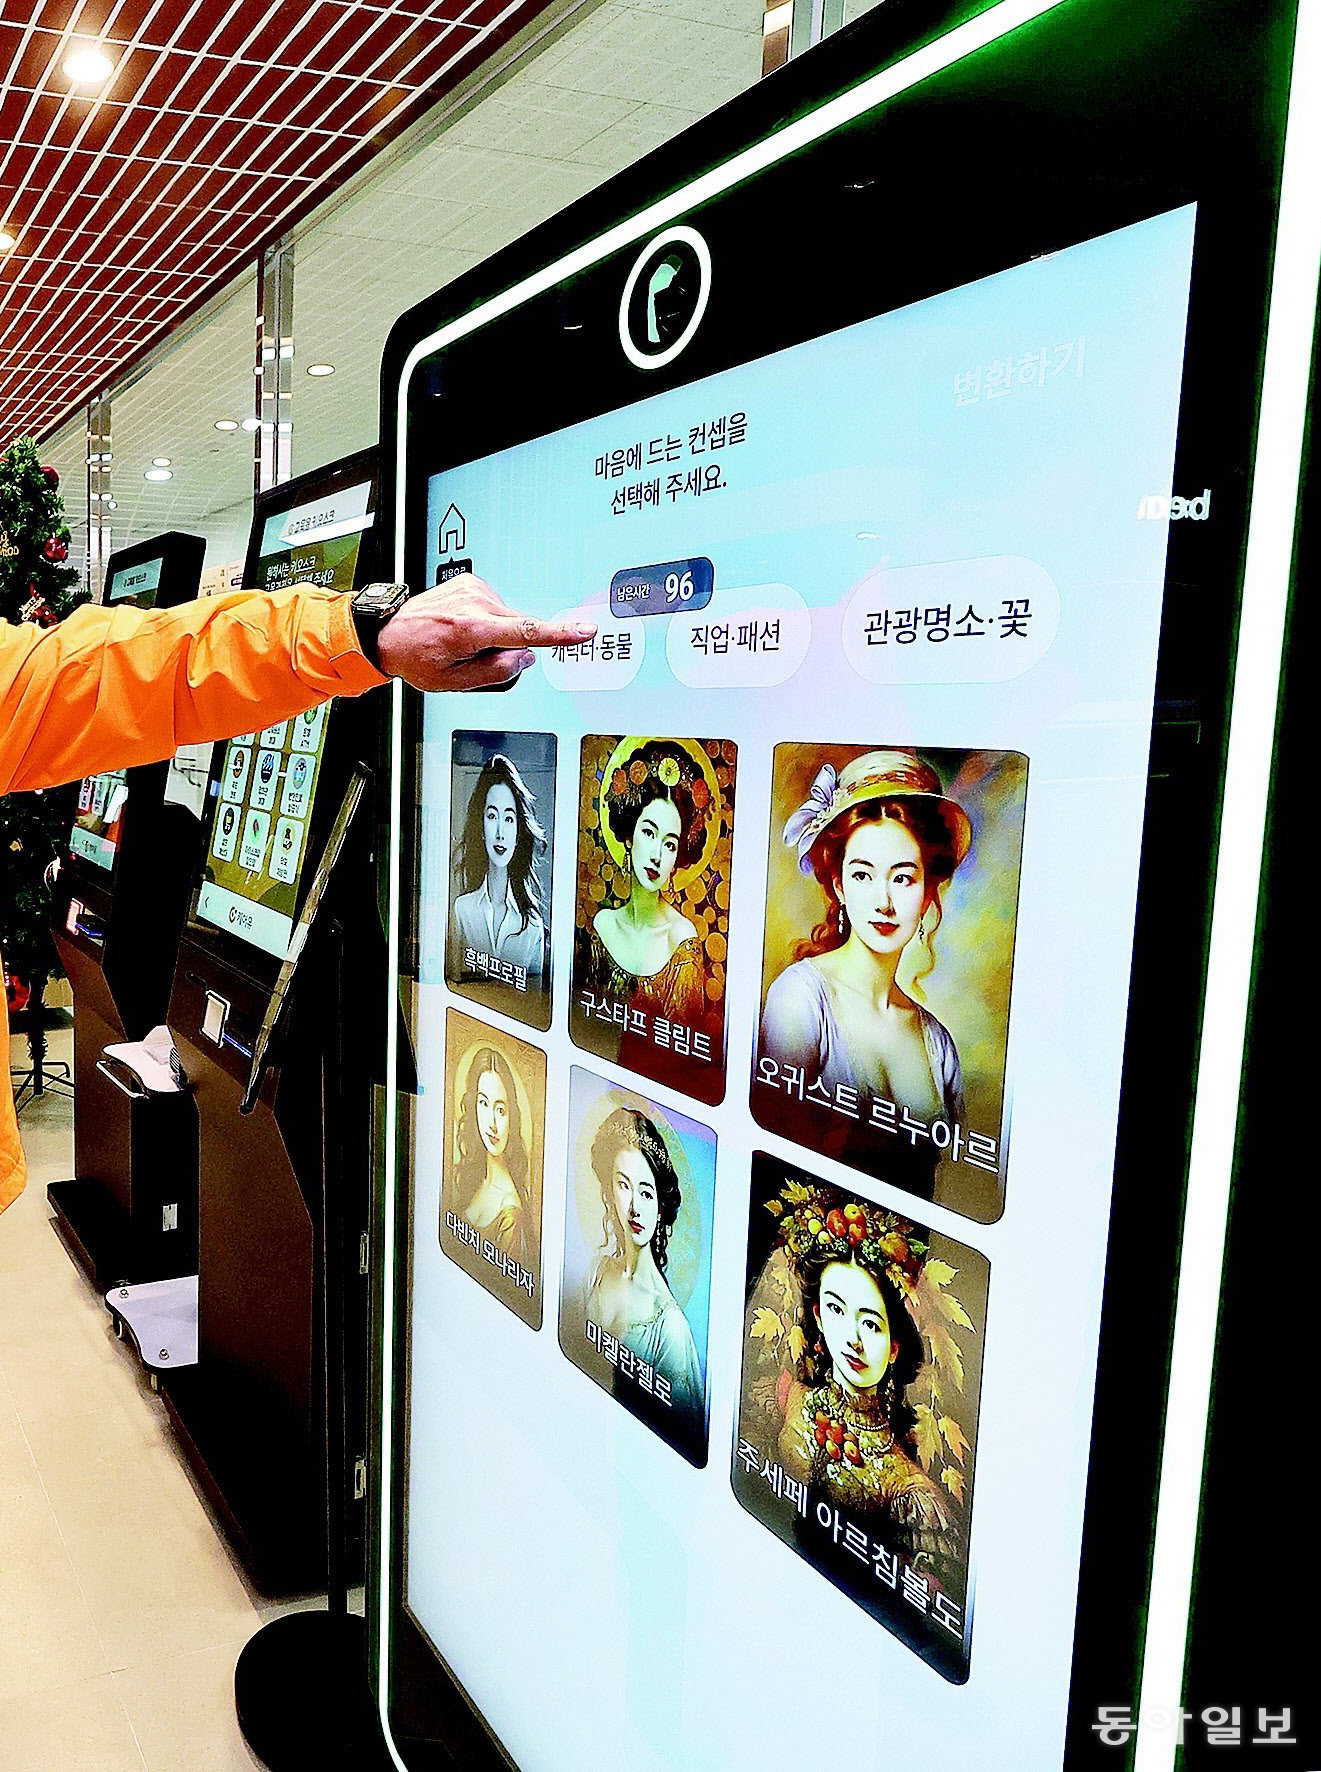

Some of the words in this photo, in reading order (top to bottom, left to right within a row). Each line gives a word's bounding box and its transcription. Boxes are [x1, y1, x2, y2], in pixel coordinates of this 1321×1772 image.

[953, 336, 1085, 408] 변환하기
[594, 442, 642, 480] 마음에
[646, 434, 683, 465] 드는
[688, 412, 748, 455] 컨셉을
[610, 477, 660, 516] 선택해
[665, 464, 727, 503] 주세요.
[665, 570, 694, 603] 96
[863, 598, 1033, 645] 관광명소·꽃
[690, 618, 781, 655] 직업·패션
[464, 947, 528, 992] 흑백프로필
[579, 990, 648, 1037] 구스타프
[652, 1015, 712, 1062] 클림트
[756, 1056, 860, 1120] 오귀스트
[868, 1096, 999, 1174] 르누아르
[445, 1210, 481, 1255] 다빈치
[482, 1242, 535, 1298] 모나리자
[585, 1319, 673, 1408] 미켈란젤로
[736, 1438, 808, 1518] 주세페
[816, 1501, 964, 1641] 아르침볼도
